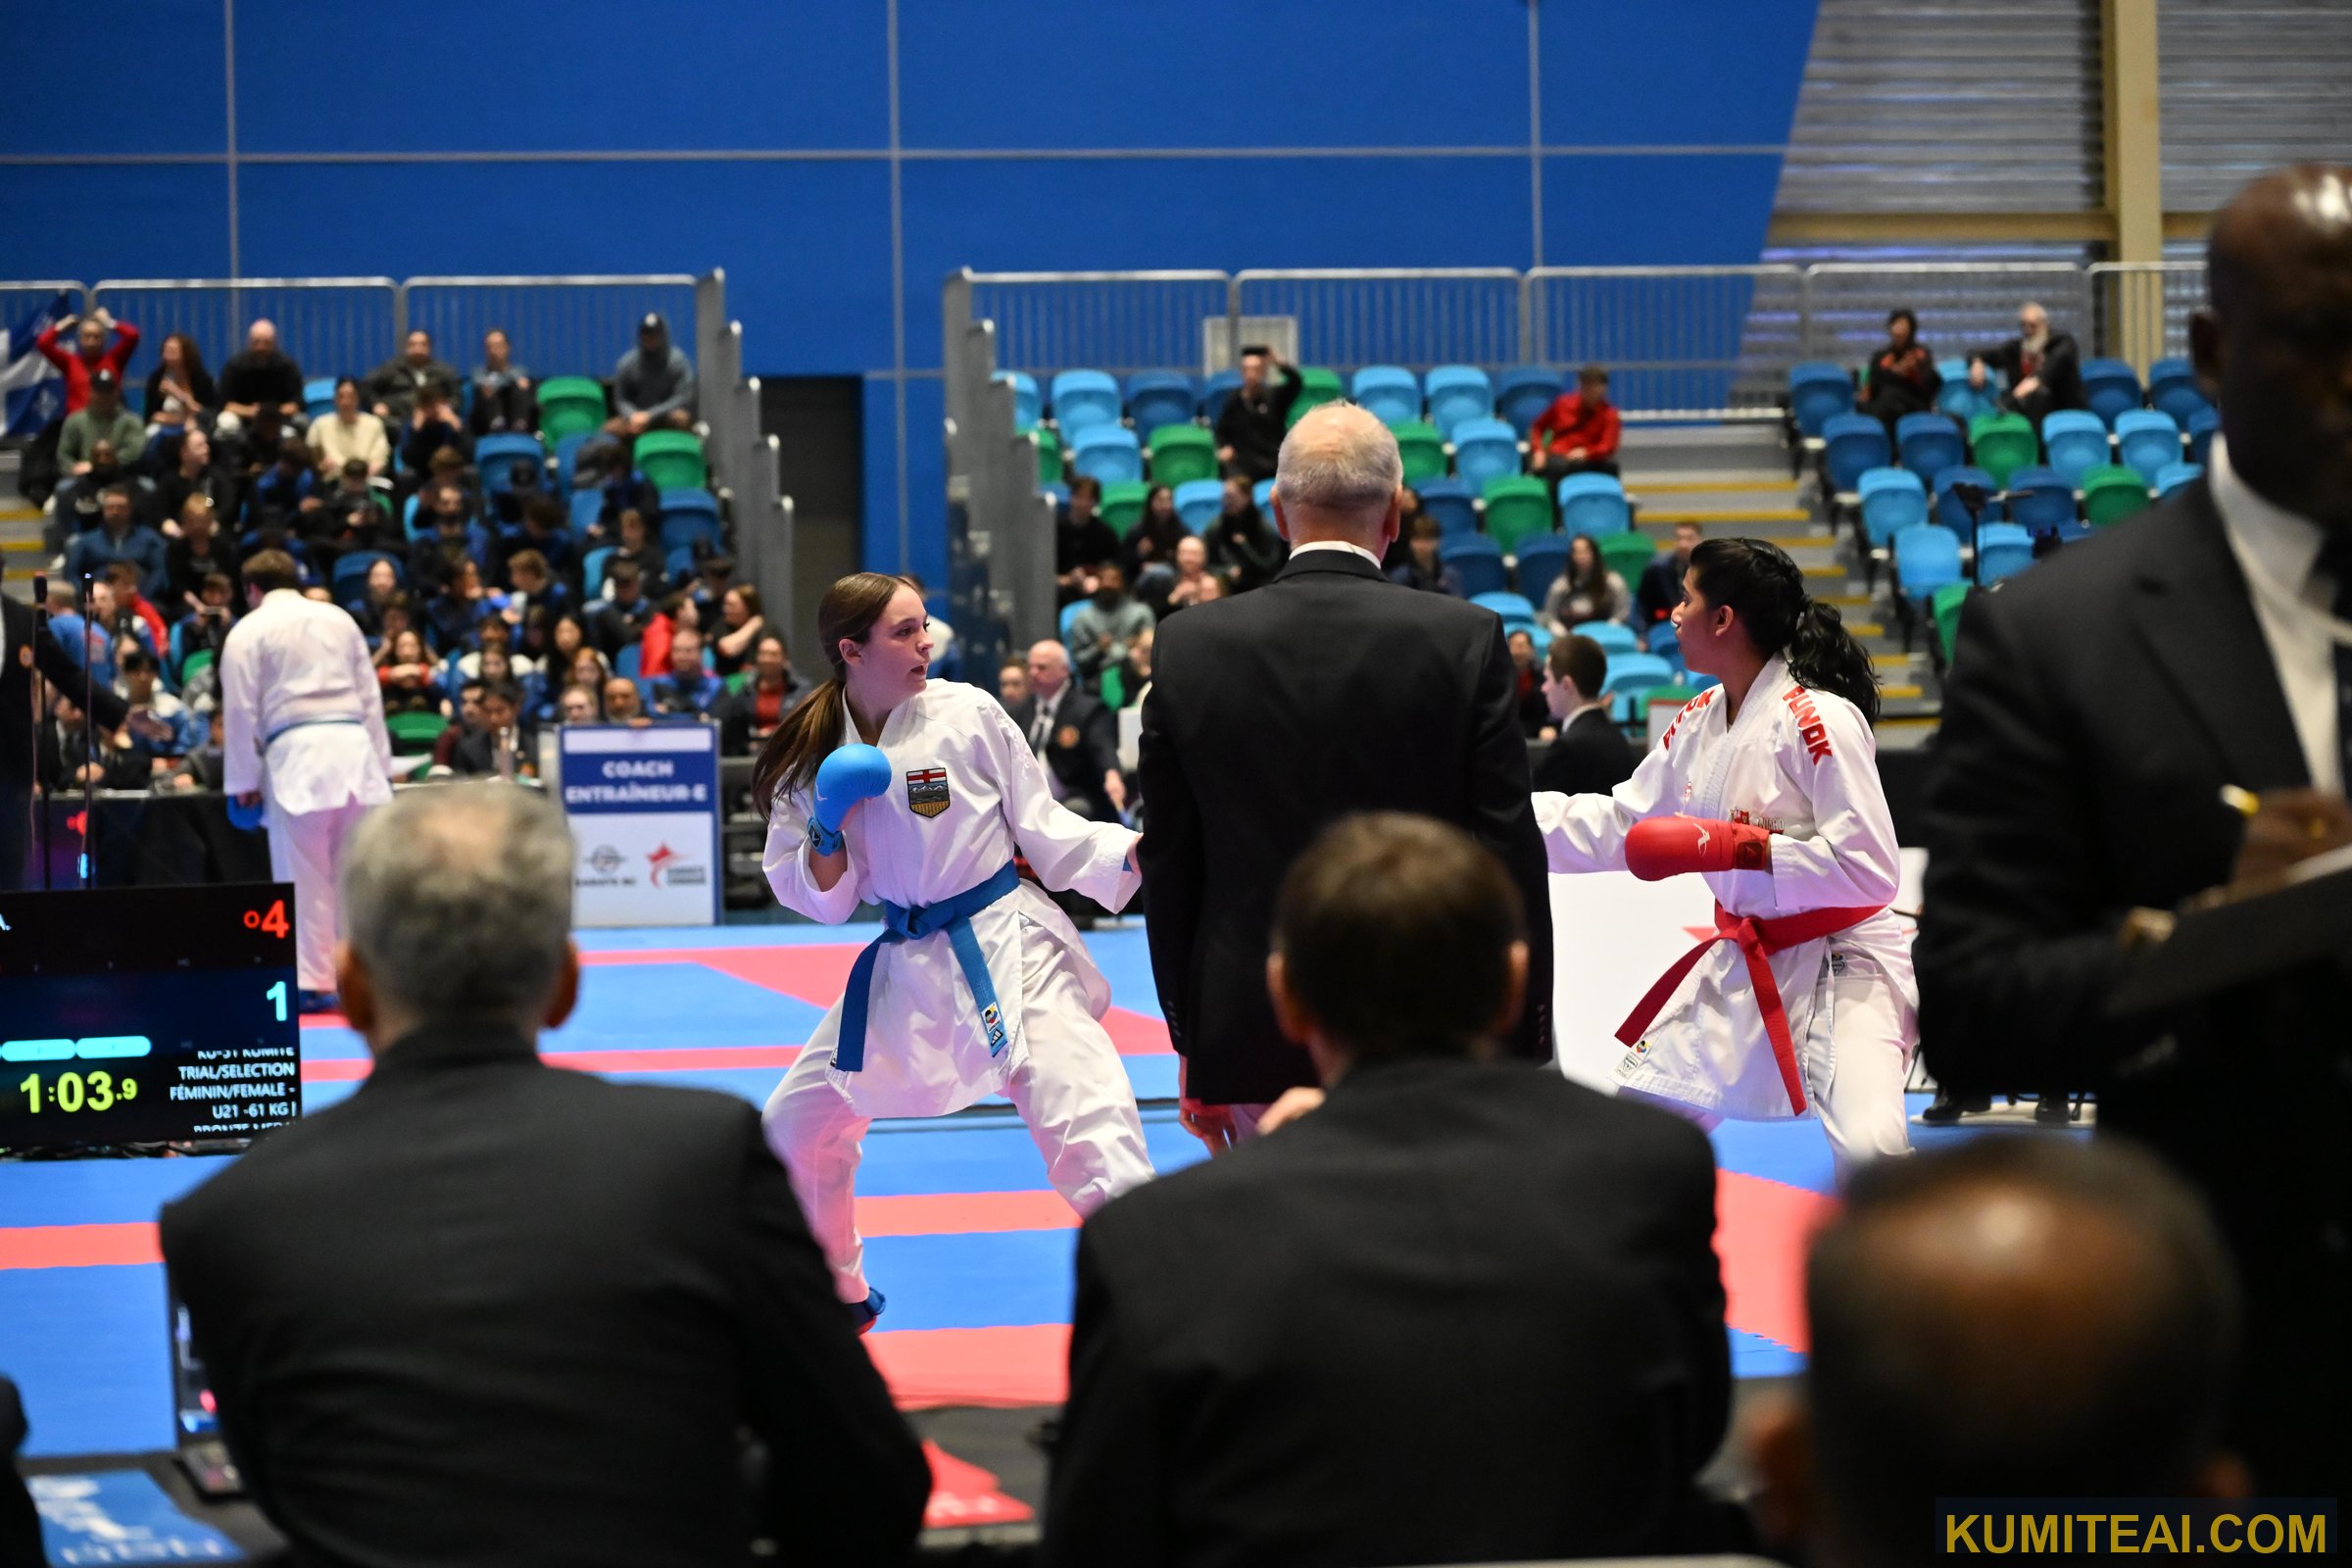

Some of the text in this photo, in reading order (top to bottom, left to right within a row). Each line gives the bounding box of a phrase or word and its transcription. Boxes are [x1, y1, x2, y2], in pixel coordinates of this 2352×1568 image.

[1782, 686, 1834, 766] PUNOK
[602, 760, 673, 777] COACH
[267, 981, 287, 1021] 1
[178, 1062, 295, 1080] TRIAL/SELECTION
[20, 1070, 138, 1113] 1:03.9
[170, 1082, 285, 1101] FÉMININ/FEMALE
[212, 1103, 238, 1119] U21
[243, 1102, 265, 1117] -61
[269, 1102, 289, 1116] KG
